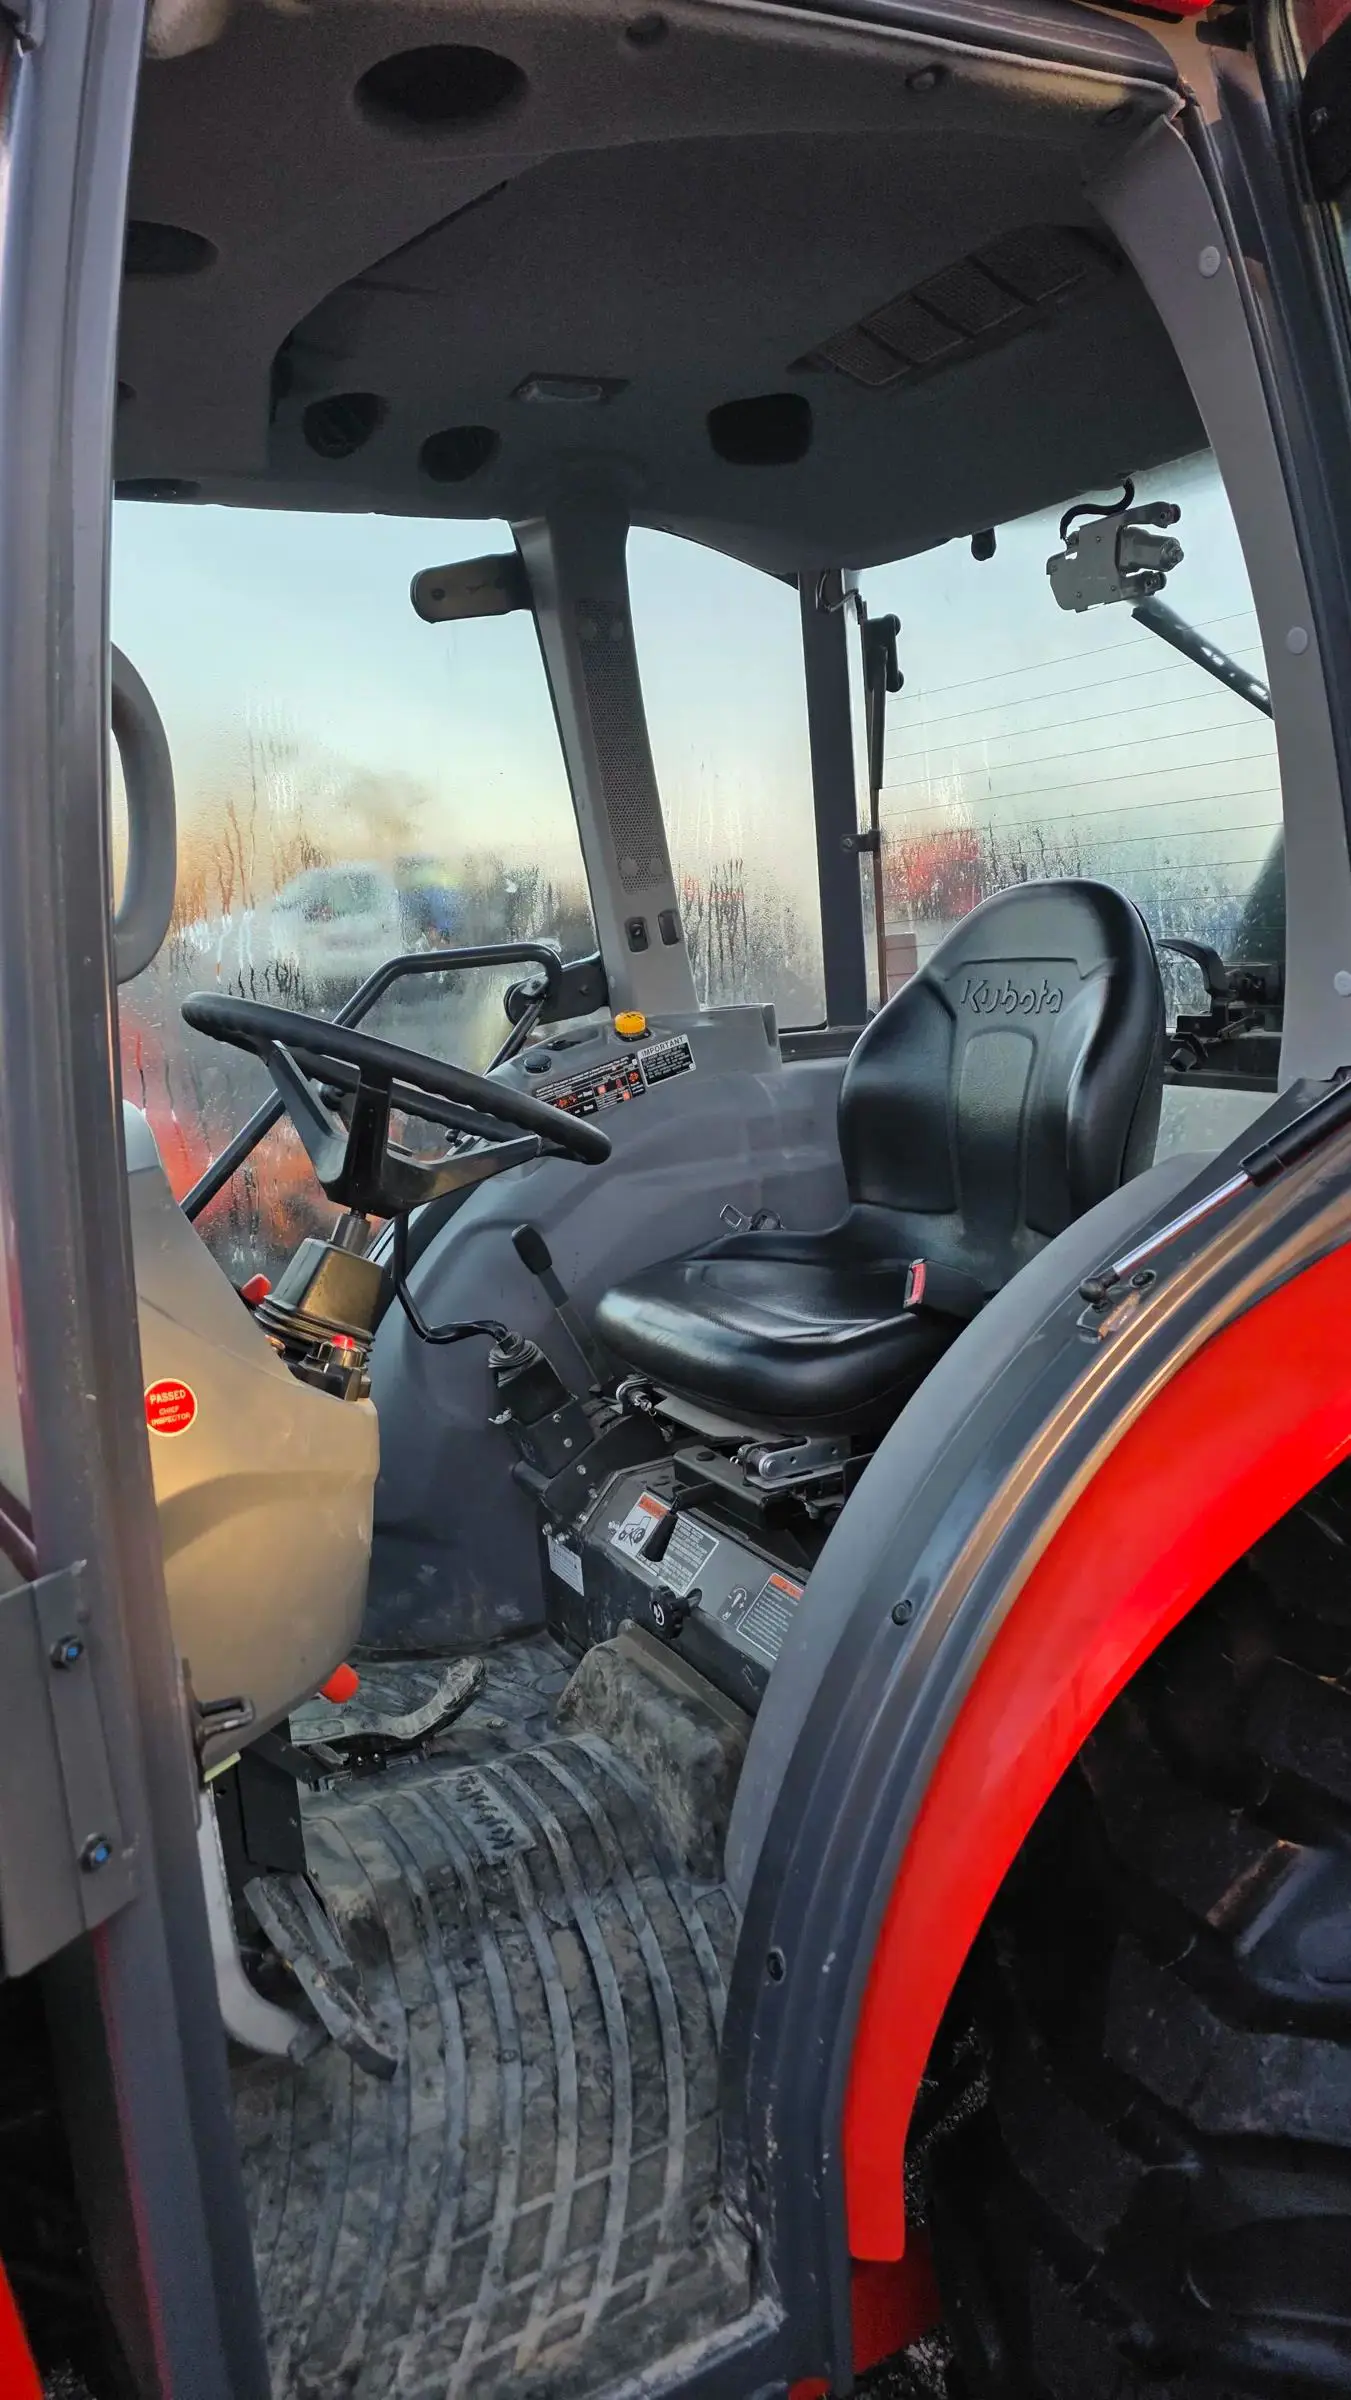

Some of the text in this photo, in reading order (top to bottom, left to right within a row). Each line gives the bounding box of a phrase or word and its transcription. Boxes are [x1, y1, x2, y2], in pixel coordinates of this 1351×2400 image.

[960, 977, 1064, 1014] Kubota
[641, 1036, 685, 1056] IMPORTANT
[149, 1389, 186, 1405] PASSED
[158, 1405, 180, 1416] CHIEF
[151, 1412, 191, 1426] INSPECTOR
